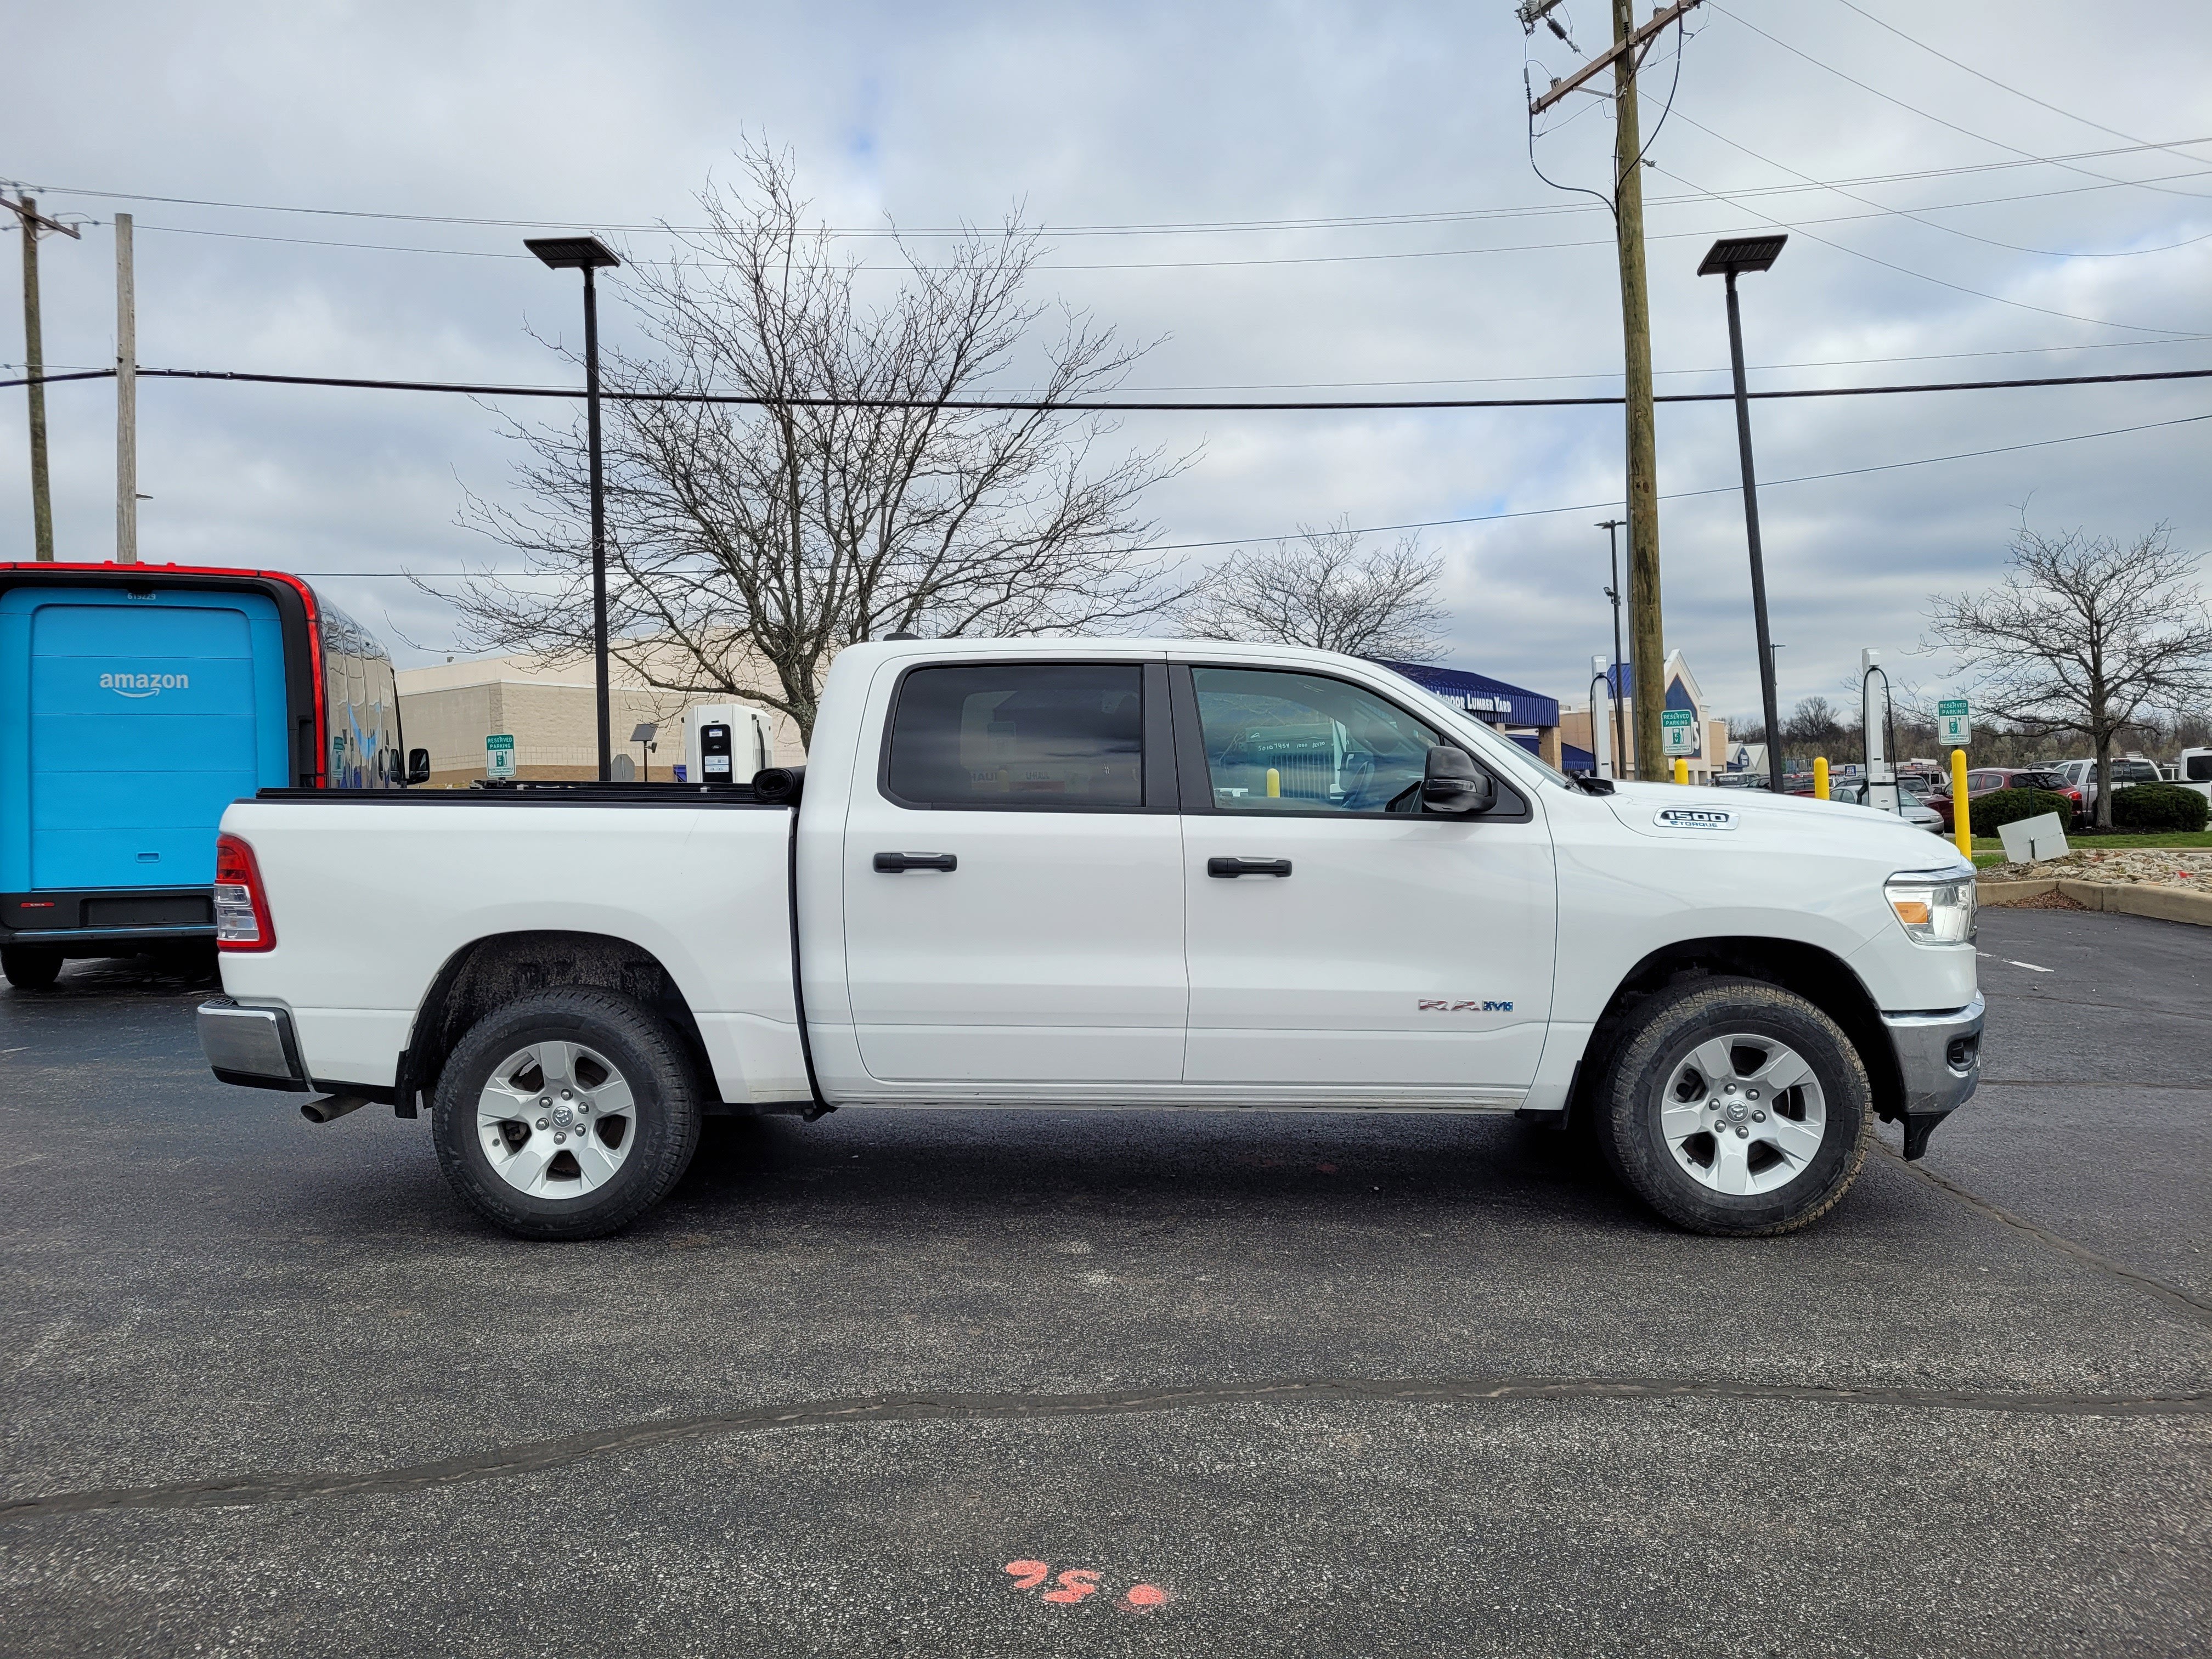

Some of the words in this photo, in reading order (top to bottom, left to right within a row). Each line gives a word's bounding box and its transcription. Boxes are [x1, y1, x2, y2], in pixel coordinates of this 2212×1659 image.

[100, 673, 189, 689] amazon
[1467, 693, 1494, 711] LUMBER
[1494, 696, 1511, 713] YARD
[1666, 811, 1726, 822] 1500
[1419, 999, 1514, 1012] RAM
